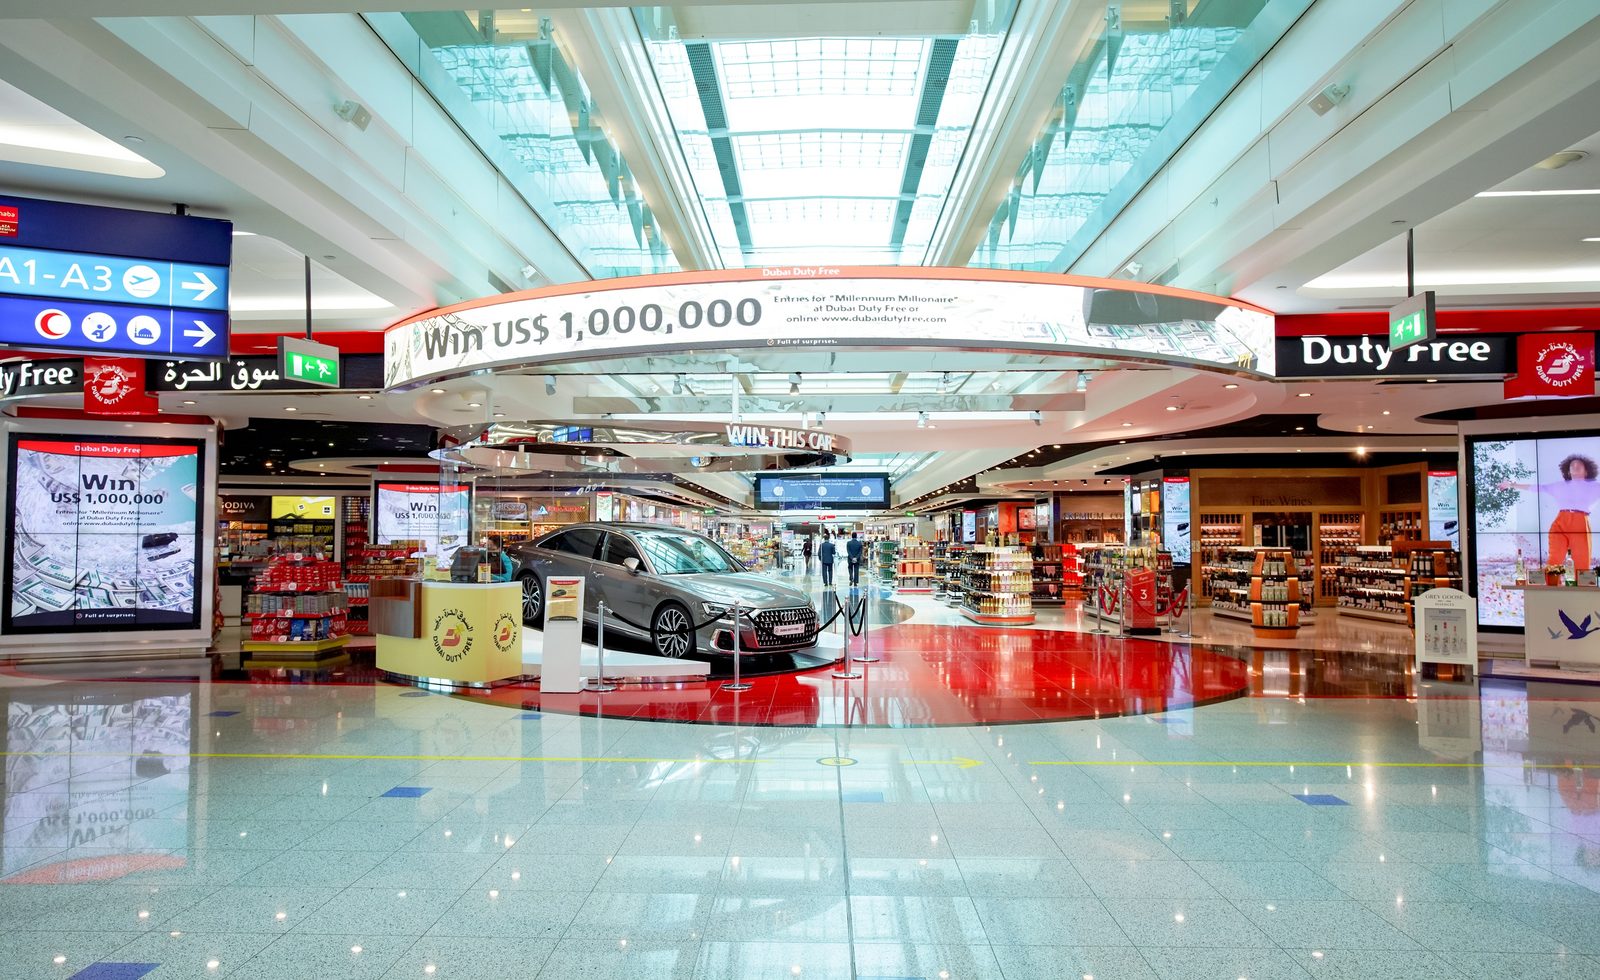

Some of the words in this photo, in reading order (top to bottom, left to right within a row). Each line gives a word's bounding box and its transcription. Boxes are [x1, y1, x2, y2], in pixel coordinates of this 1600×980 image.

[0, 256, 112, 291] A1-A3
[762, 268, 791, 277] Dubai
[793, 267, 816, 277] Duty
[818, 267, 840, 275] Free
[774, 295, 809, 303] Entries
[830, 294, 896, 302] "Millennium
[898, 295, 958, 304] Millionaire"
[858, 305, 882, 313] Duty
[885, 304, 907, 312] Free
[786, 315, 819, 323] online
[821, 314, 947, 323] www.dubaidutyfree.com
[425, 324, 484, 360] Win
[493, 314, 550, 347] US$
[559, 297, 762, 342] 1,000,000
[1300, 334, 1393, 370] Duty
[20, 363, 74, 387] Free
[1535, 365, 1551, 384] DUBAI
[1552, 378, 1572, 387] DUTY
[1571, 365, 1584, 381] FREE
[91, 385, 103, 402] DUBAI
[103, 397, 119, 405] DUTY
[726, 425, 767, 445] WIN
[770, 428, 805, 448] THIS
[808, 432, 833, 452] CAR
[101, 446, 122, 454] Duty
[82, 474, 135, 490] Win
[51, 492, 81, 504] US$
[85, 493, 164, 505] 1,000,000
[1251, 495, 1276, 506] Fine
[1279, 495, 1313, 506] Wines
[410, 502, 437, 511] Win
[1140, 589, 1148, 600] 3
[433, 635, 446, 658] DUBAI
[445, 653, 462, 662] DUTY
[462, 637, 473, 656] FREE
